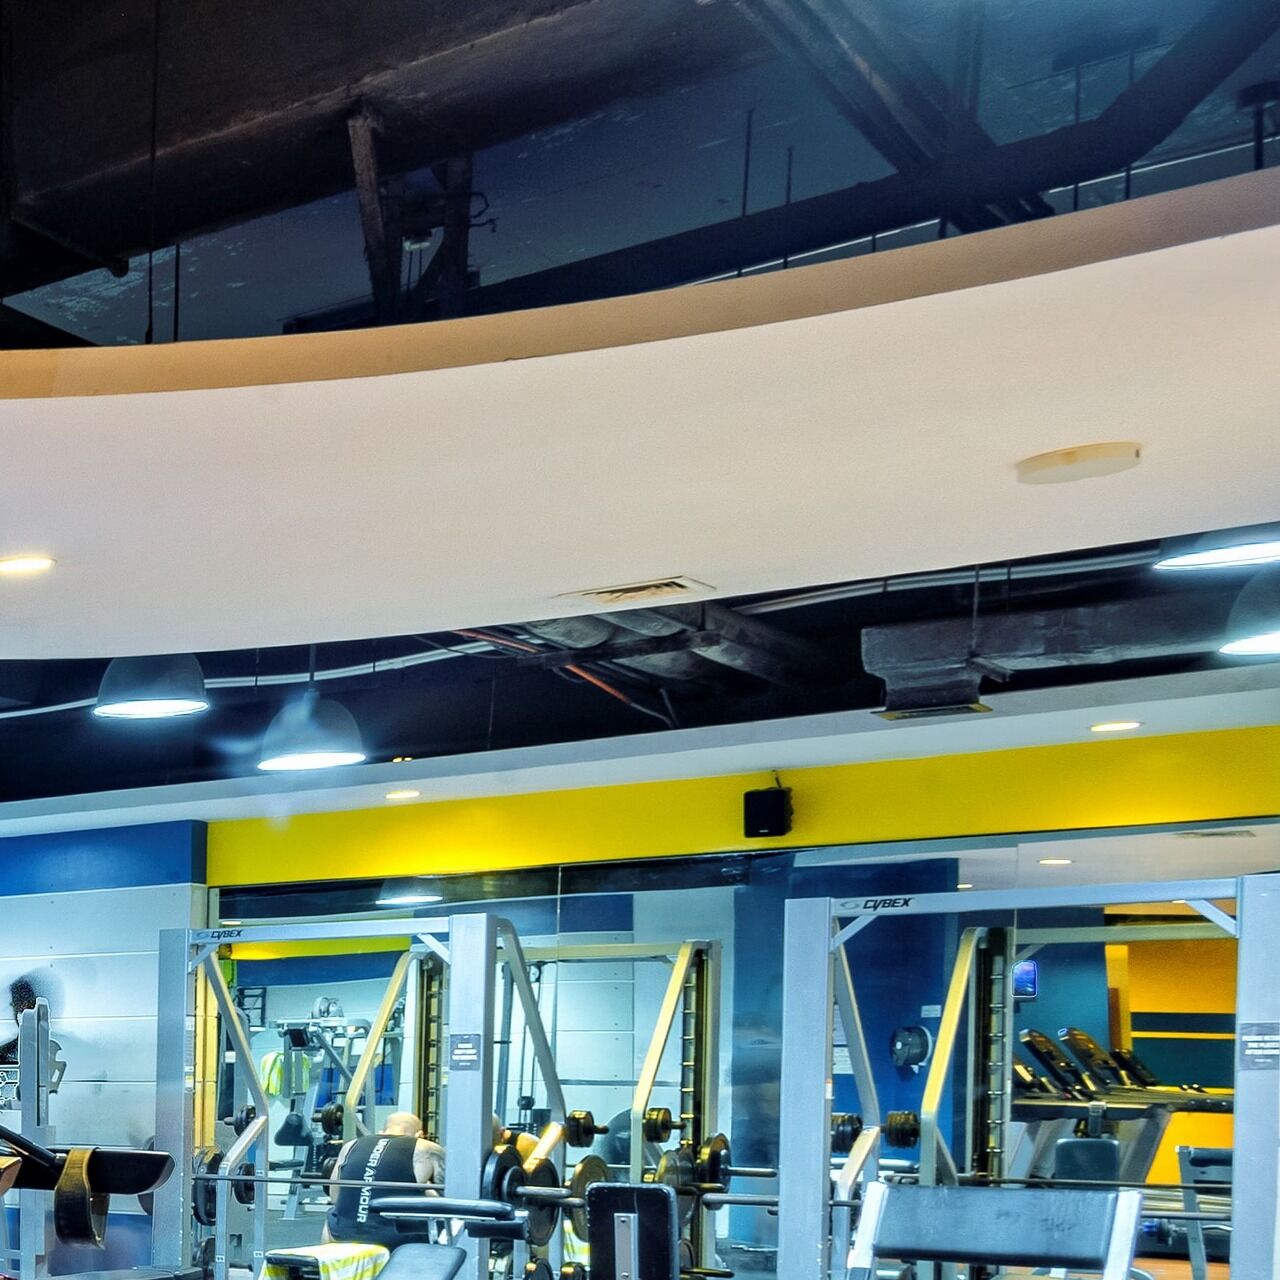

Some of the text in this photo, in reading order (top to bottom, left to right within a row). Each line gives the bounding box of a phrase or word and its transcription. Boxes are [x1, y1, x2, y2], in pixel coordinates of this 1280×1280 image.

[863, 897, 913, 912] CYBEX
[210, 929, 244, 940] CYBEX
[367, 1138, 389, 1167] UNDER
